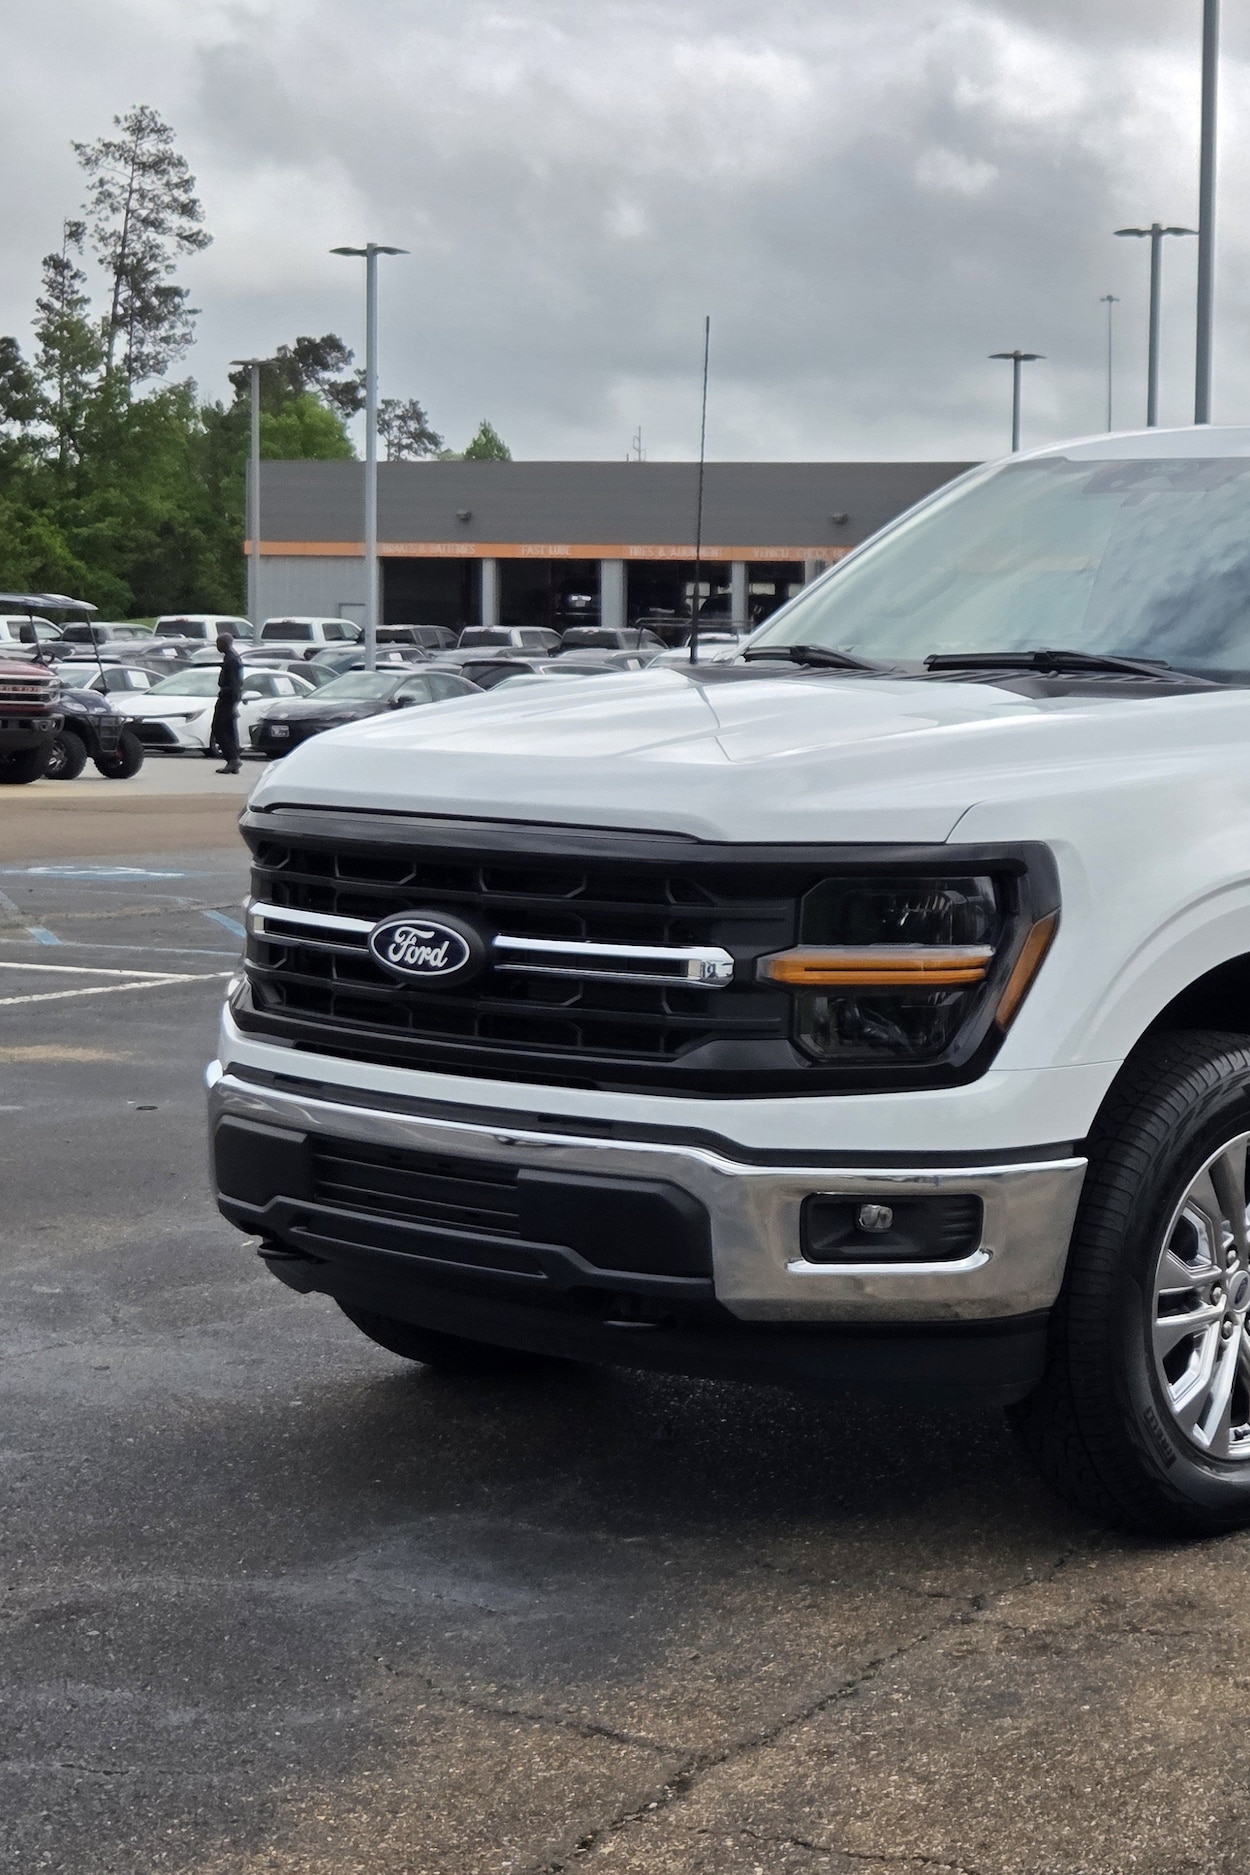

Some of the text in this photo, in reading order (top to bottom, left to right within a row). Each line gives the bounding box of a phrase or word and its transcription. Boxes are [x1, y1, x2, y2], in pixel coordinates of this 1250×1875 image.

[430, 543, 477, 555] BATTERIES
[520, 544, 571, 556] FAST LUBE
[629, 546, 654, 557] TIRES
[388, 926, 450, 968] Ford
